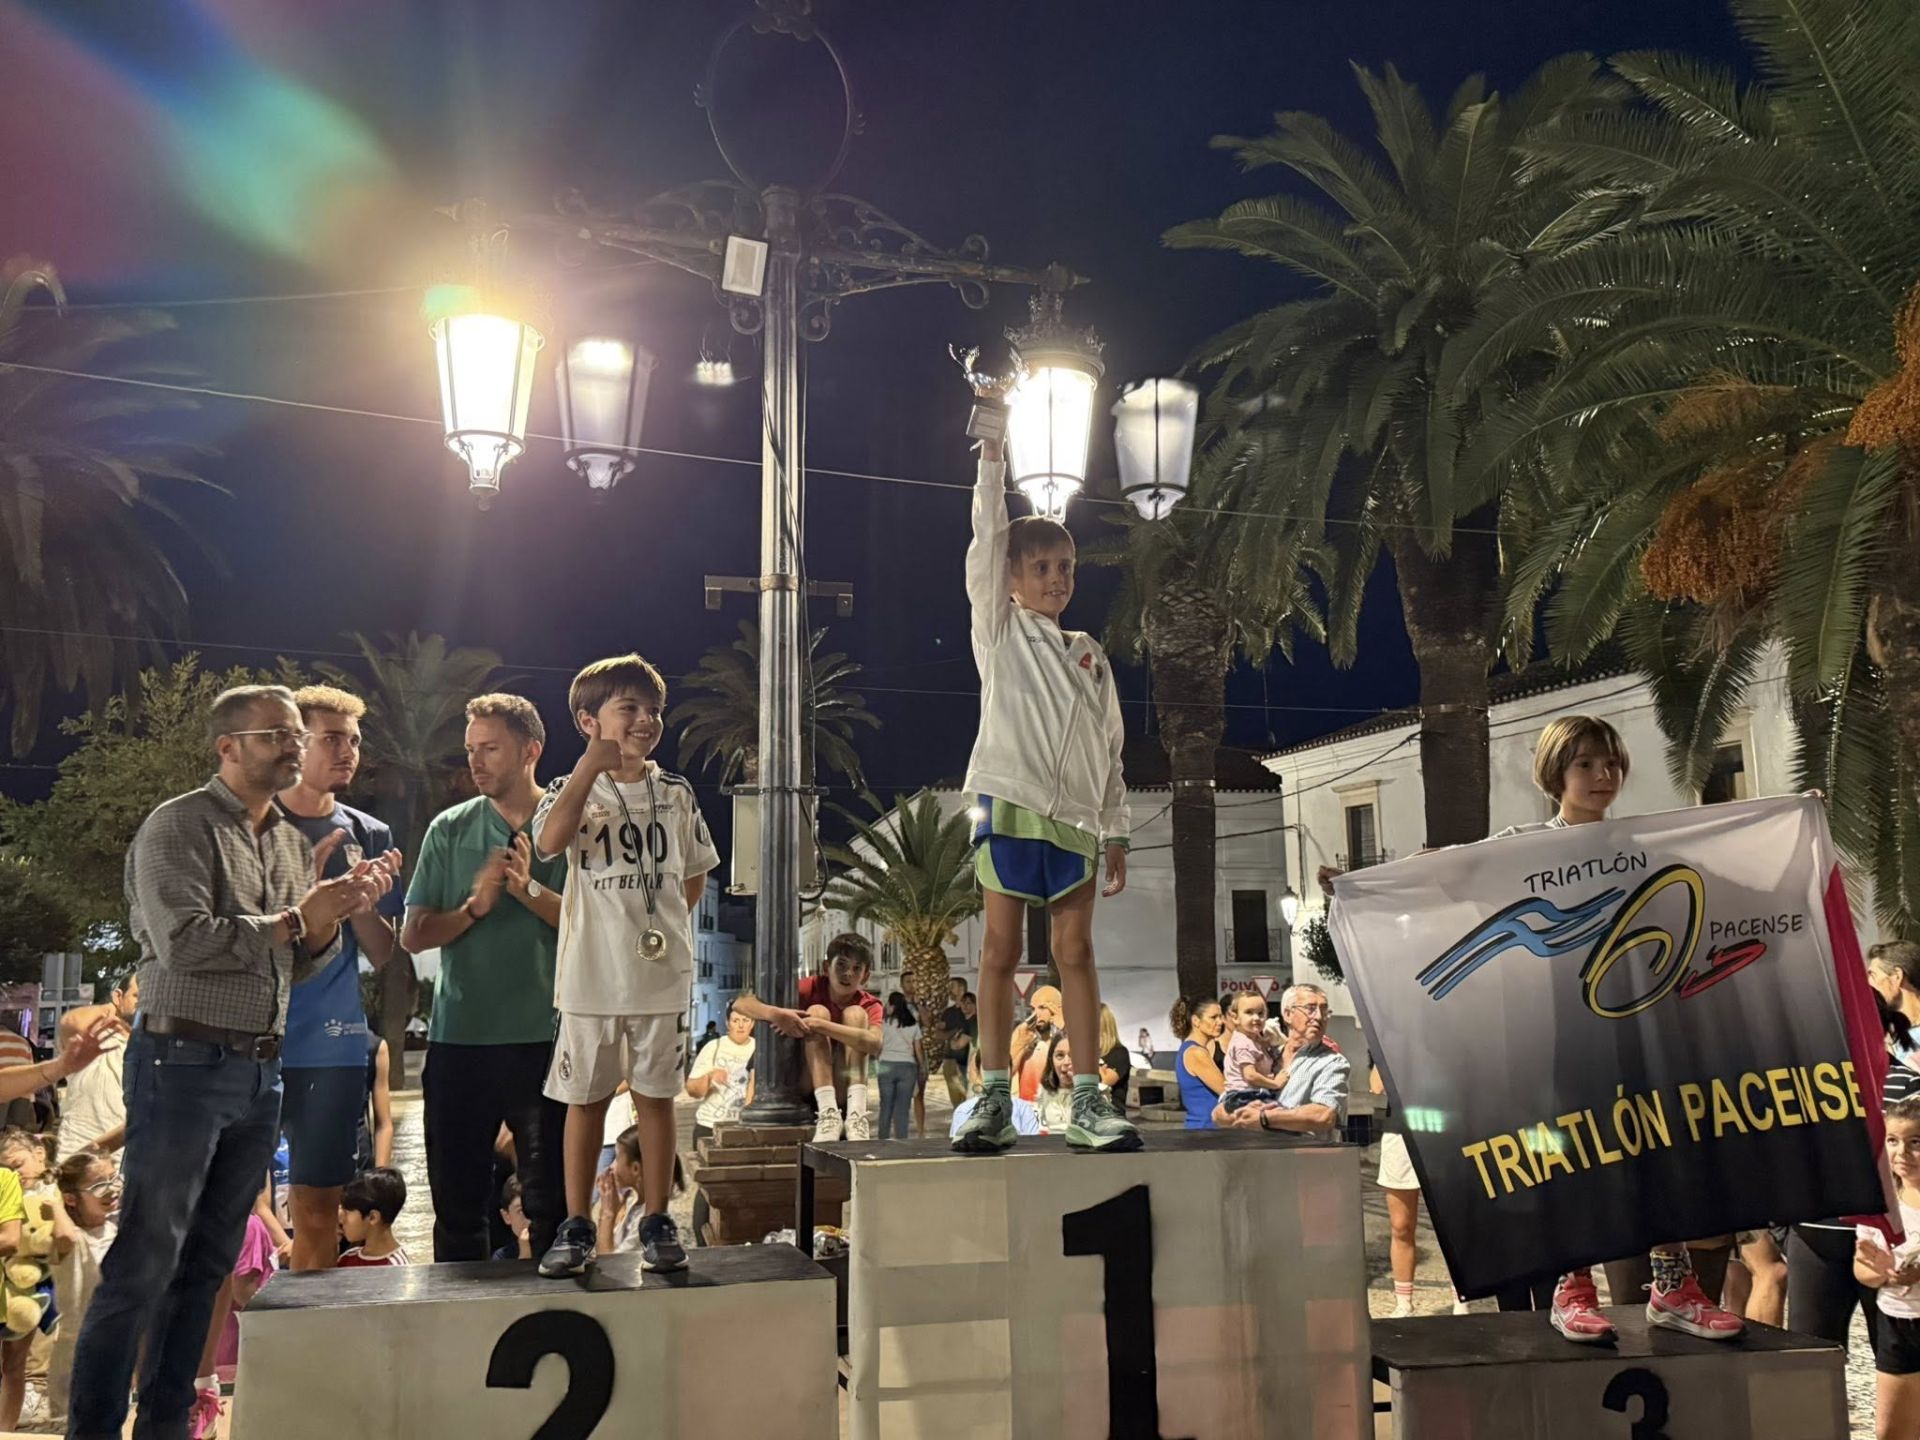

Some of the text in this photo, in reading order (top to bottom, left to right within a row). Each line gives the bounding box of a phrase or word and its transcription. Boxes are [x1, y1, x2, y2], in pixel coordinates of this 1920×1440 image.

[594, 821, 668, 867] 190
[1524, 851, 1648, 893] TRIATLÓN
[1709, 914, 1804, 940] PACENSE
[1461, 1061, 1867, 1200] TRIATLÓN PACENSE
[1062, 1184, 1198, 1440] 1
[485, 1309, 616, 1440] 2
[1602, 1367, 1670, 1440] 3
